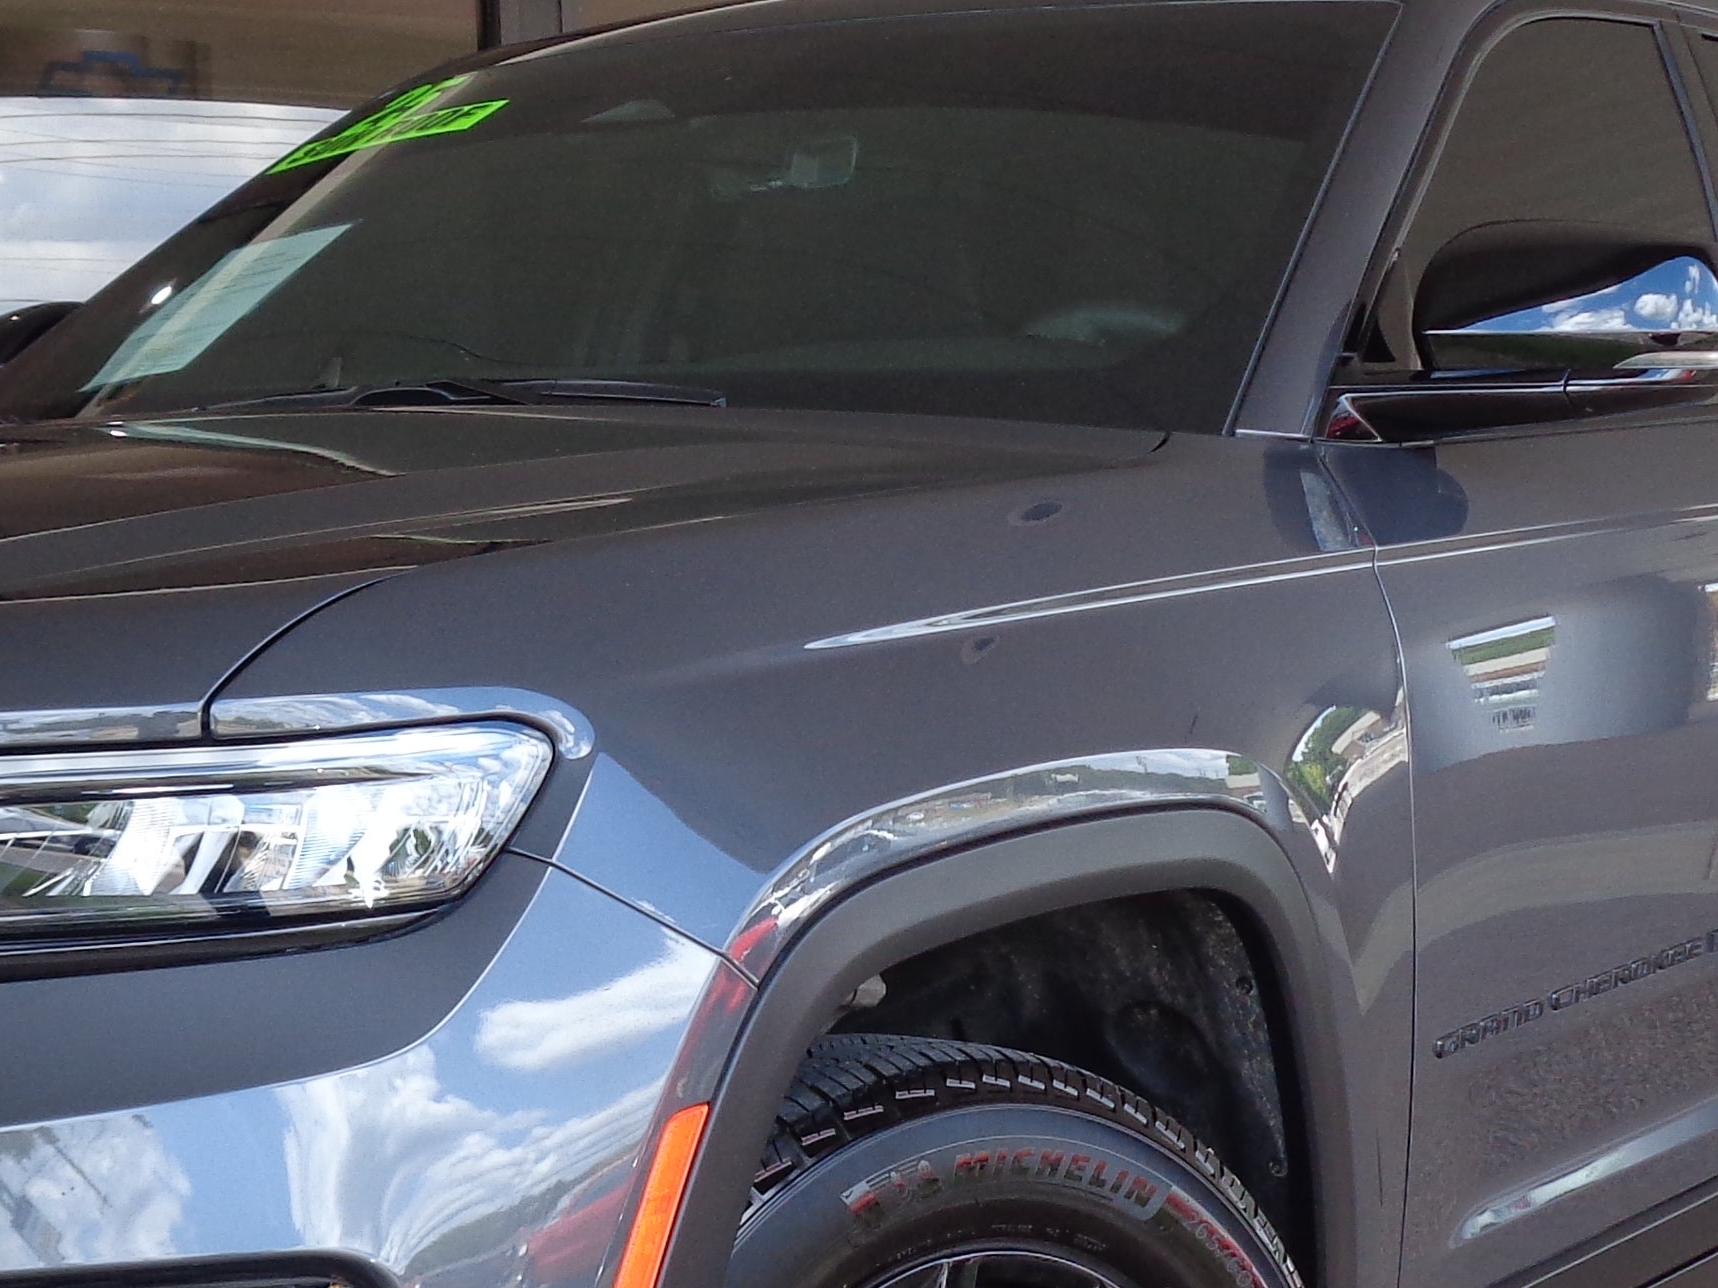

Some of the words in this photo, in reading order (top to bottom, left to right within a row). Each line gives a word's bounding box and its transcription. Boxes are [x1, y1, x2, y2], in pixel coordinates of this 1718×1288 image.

[1433, 998, 1544, 1059] GRAND
[1547, 936, 1704, 1011] CHEROKEE
[953, 1147, 1159, 1209] MICHELIN
